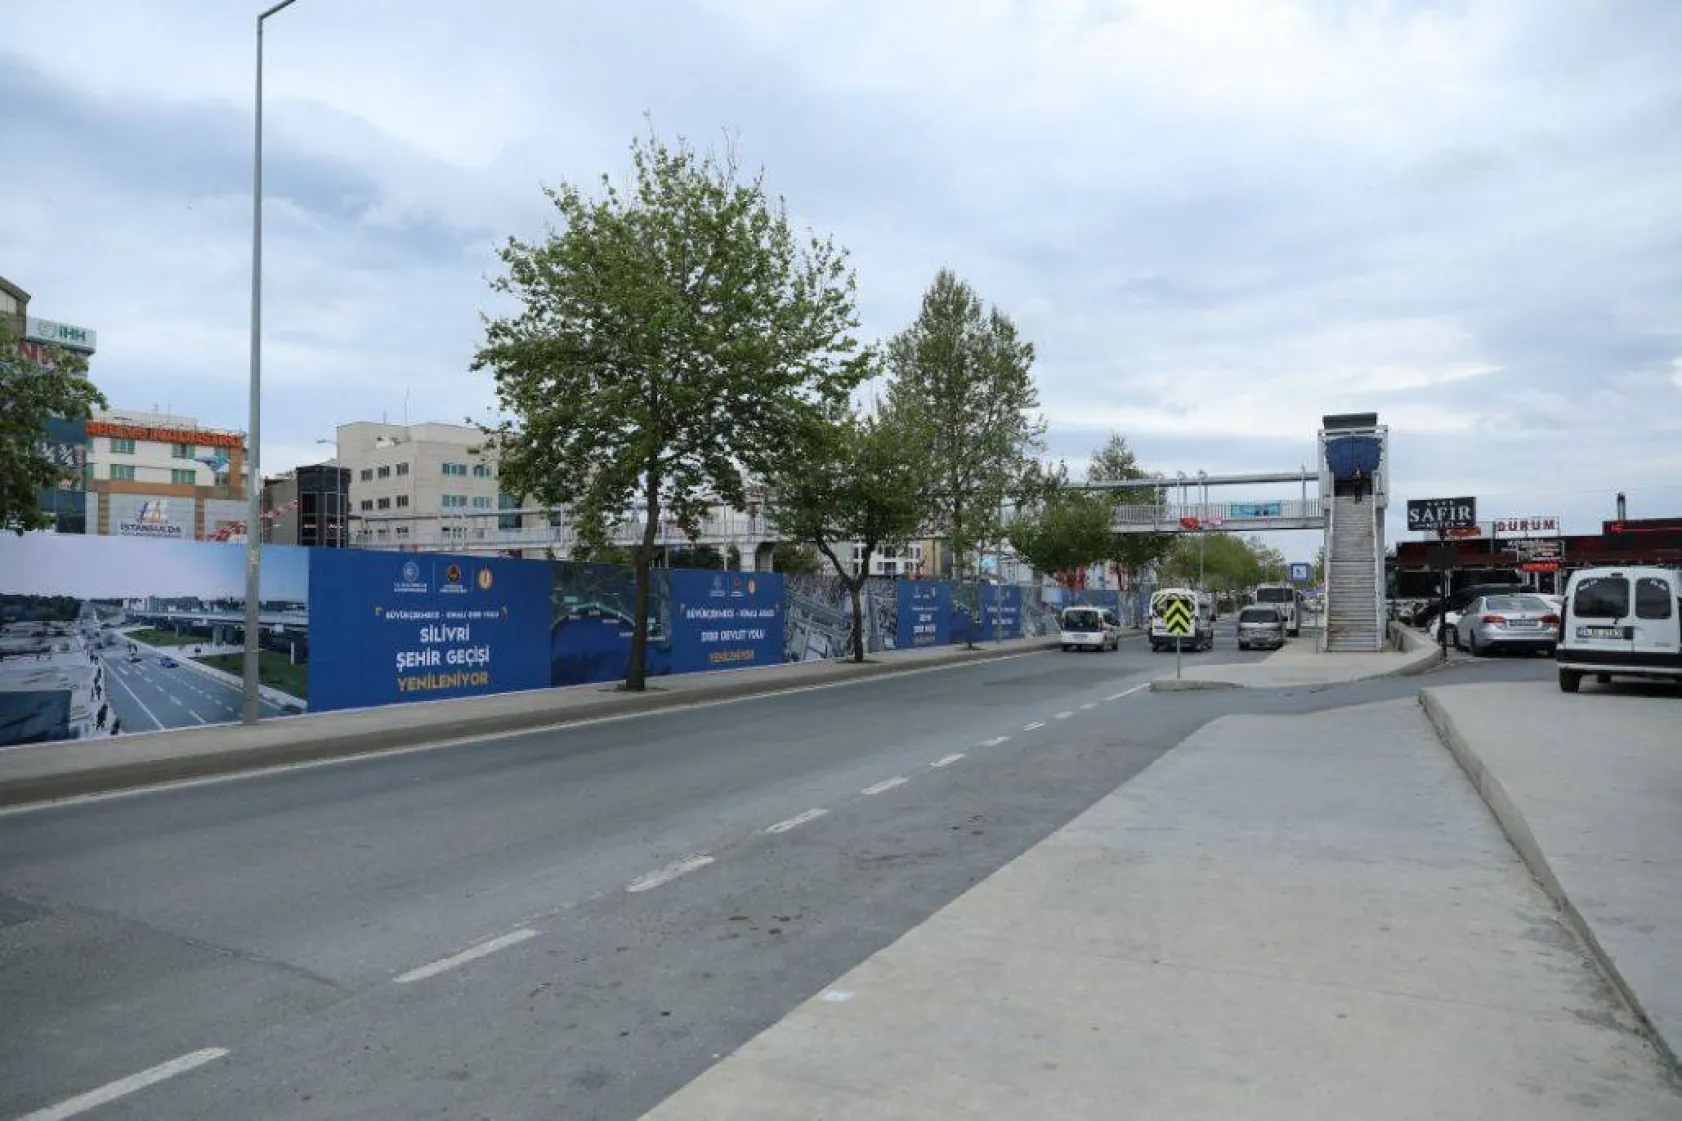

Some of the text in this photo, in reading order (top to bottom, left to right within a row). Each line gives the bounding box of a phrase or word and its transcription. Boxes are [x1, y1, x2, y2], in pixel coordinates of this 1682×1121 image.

[419, 623, 470, 643] SİLİVRİ
[396, 644, 490, 673] ŞEHİR GEÇİŞİ
[397, 670, 490, 692] YENİLENİYOR
